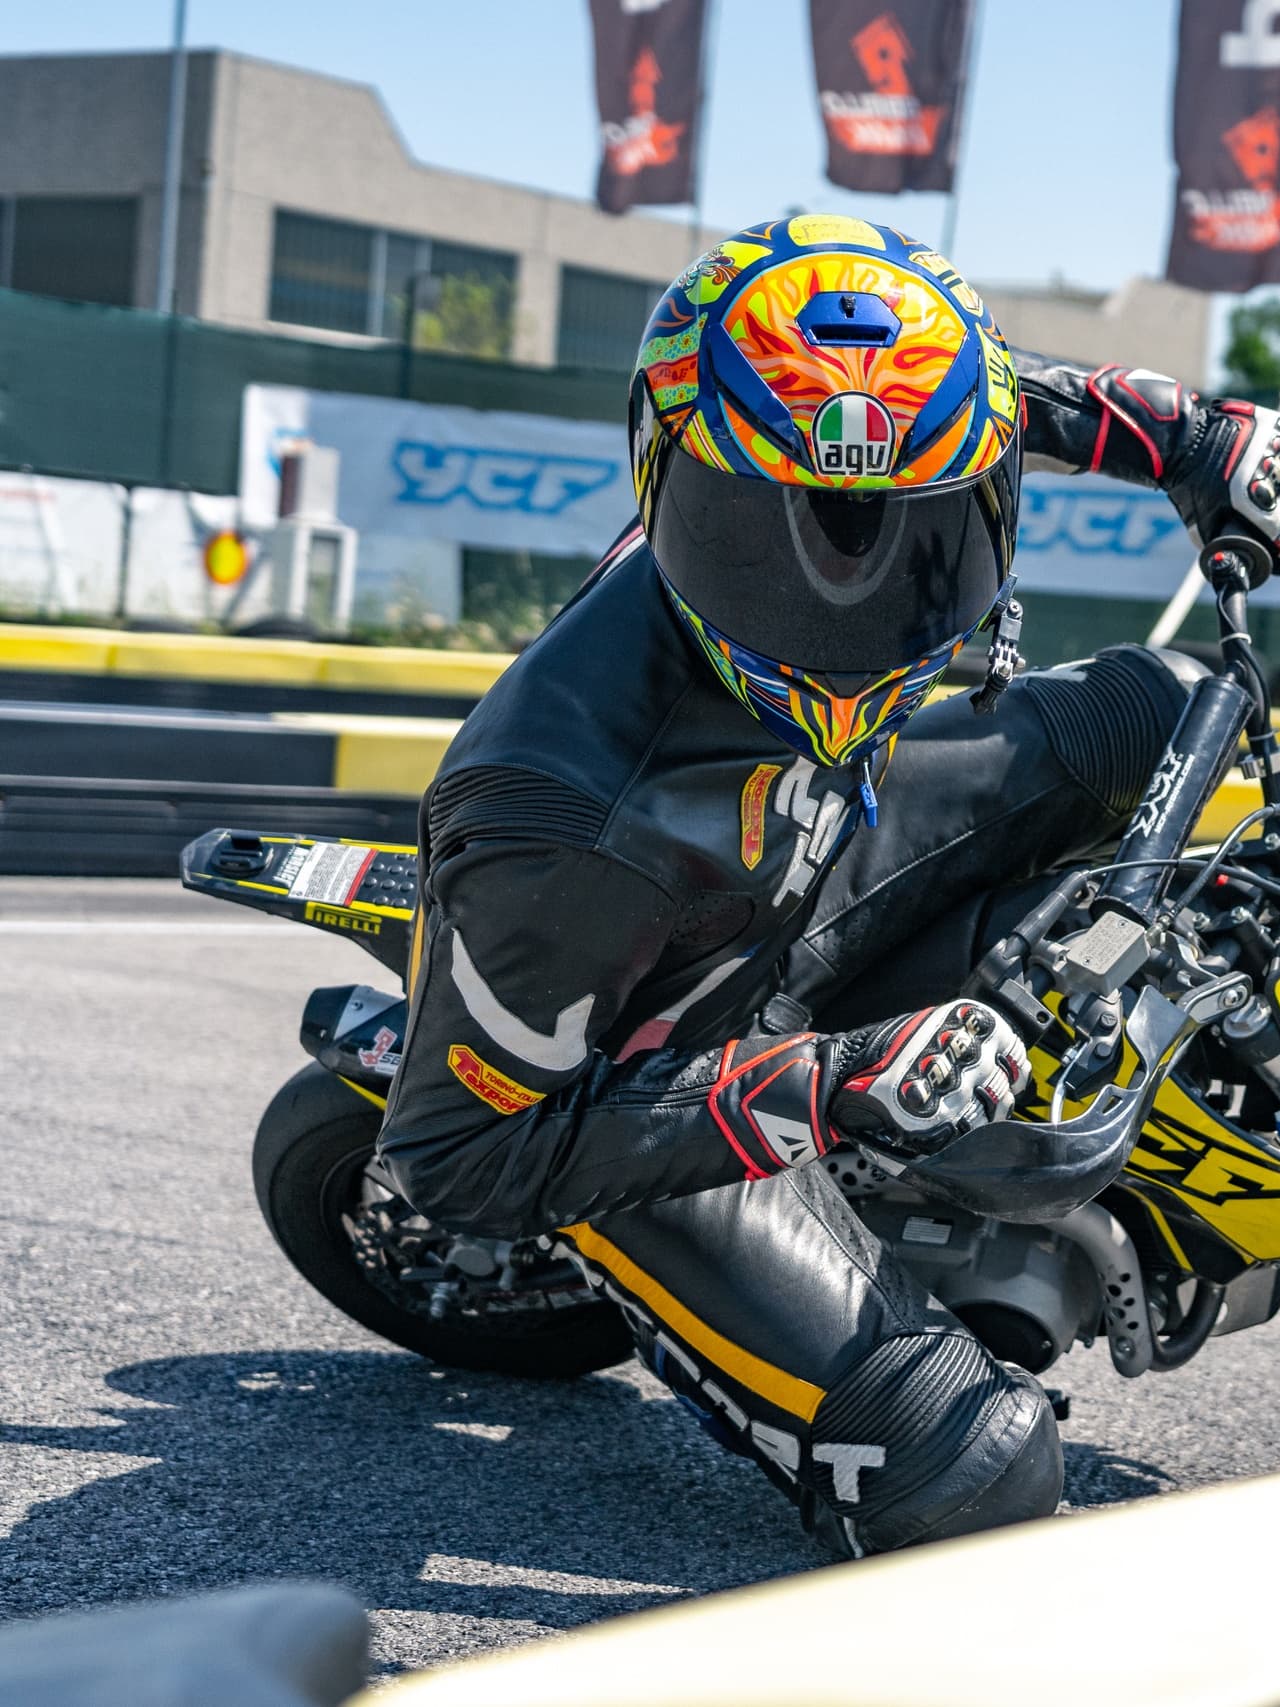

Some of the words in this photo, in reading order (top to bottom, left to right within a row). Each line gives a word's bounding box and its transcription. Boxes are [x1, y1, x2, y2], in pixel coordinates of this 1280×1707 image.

[394, 440, 618, 516] YCF
[824, 443, 887, 477] agv
[1018, 488, 1183, 556] YCF
[305, 901, 382, 935] PIRELLI
